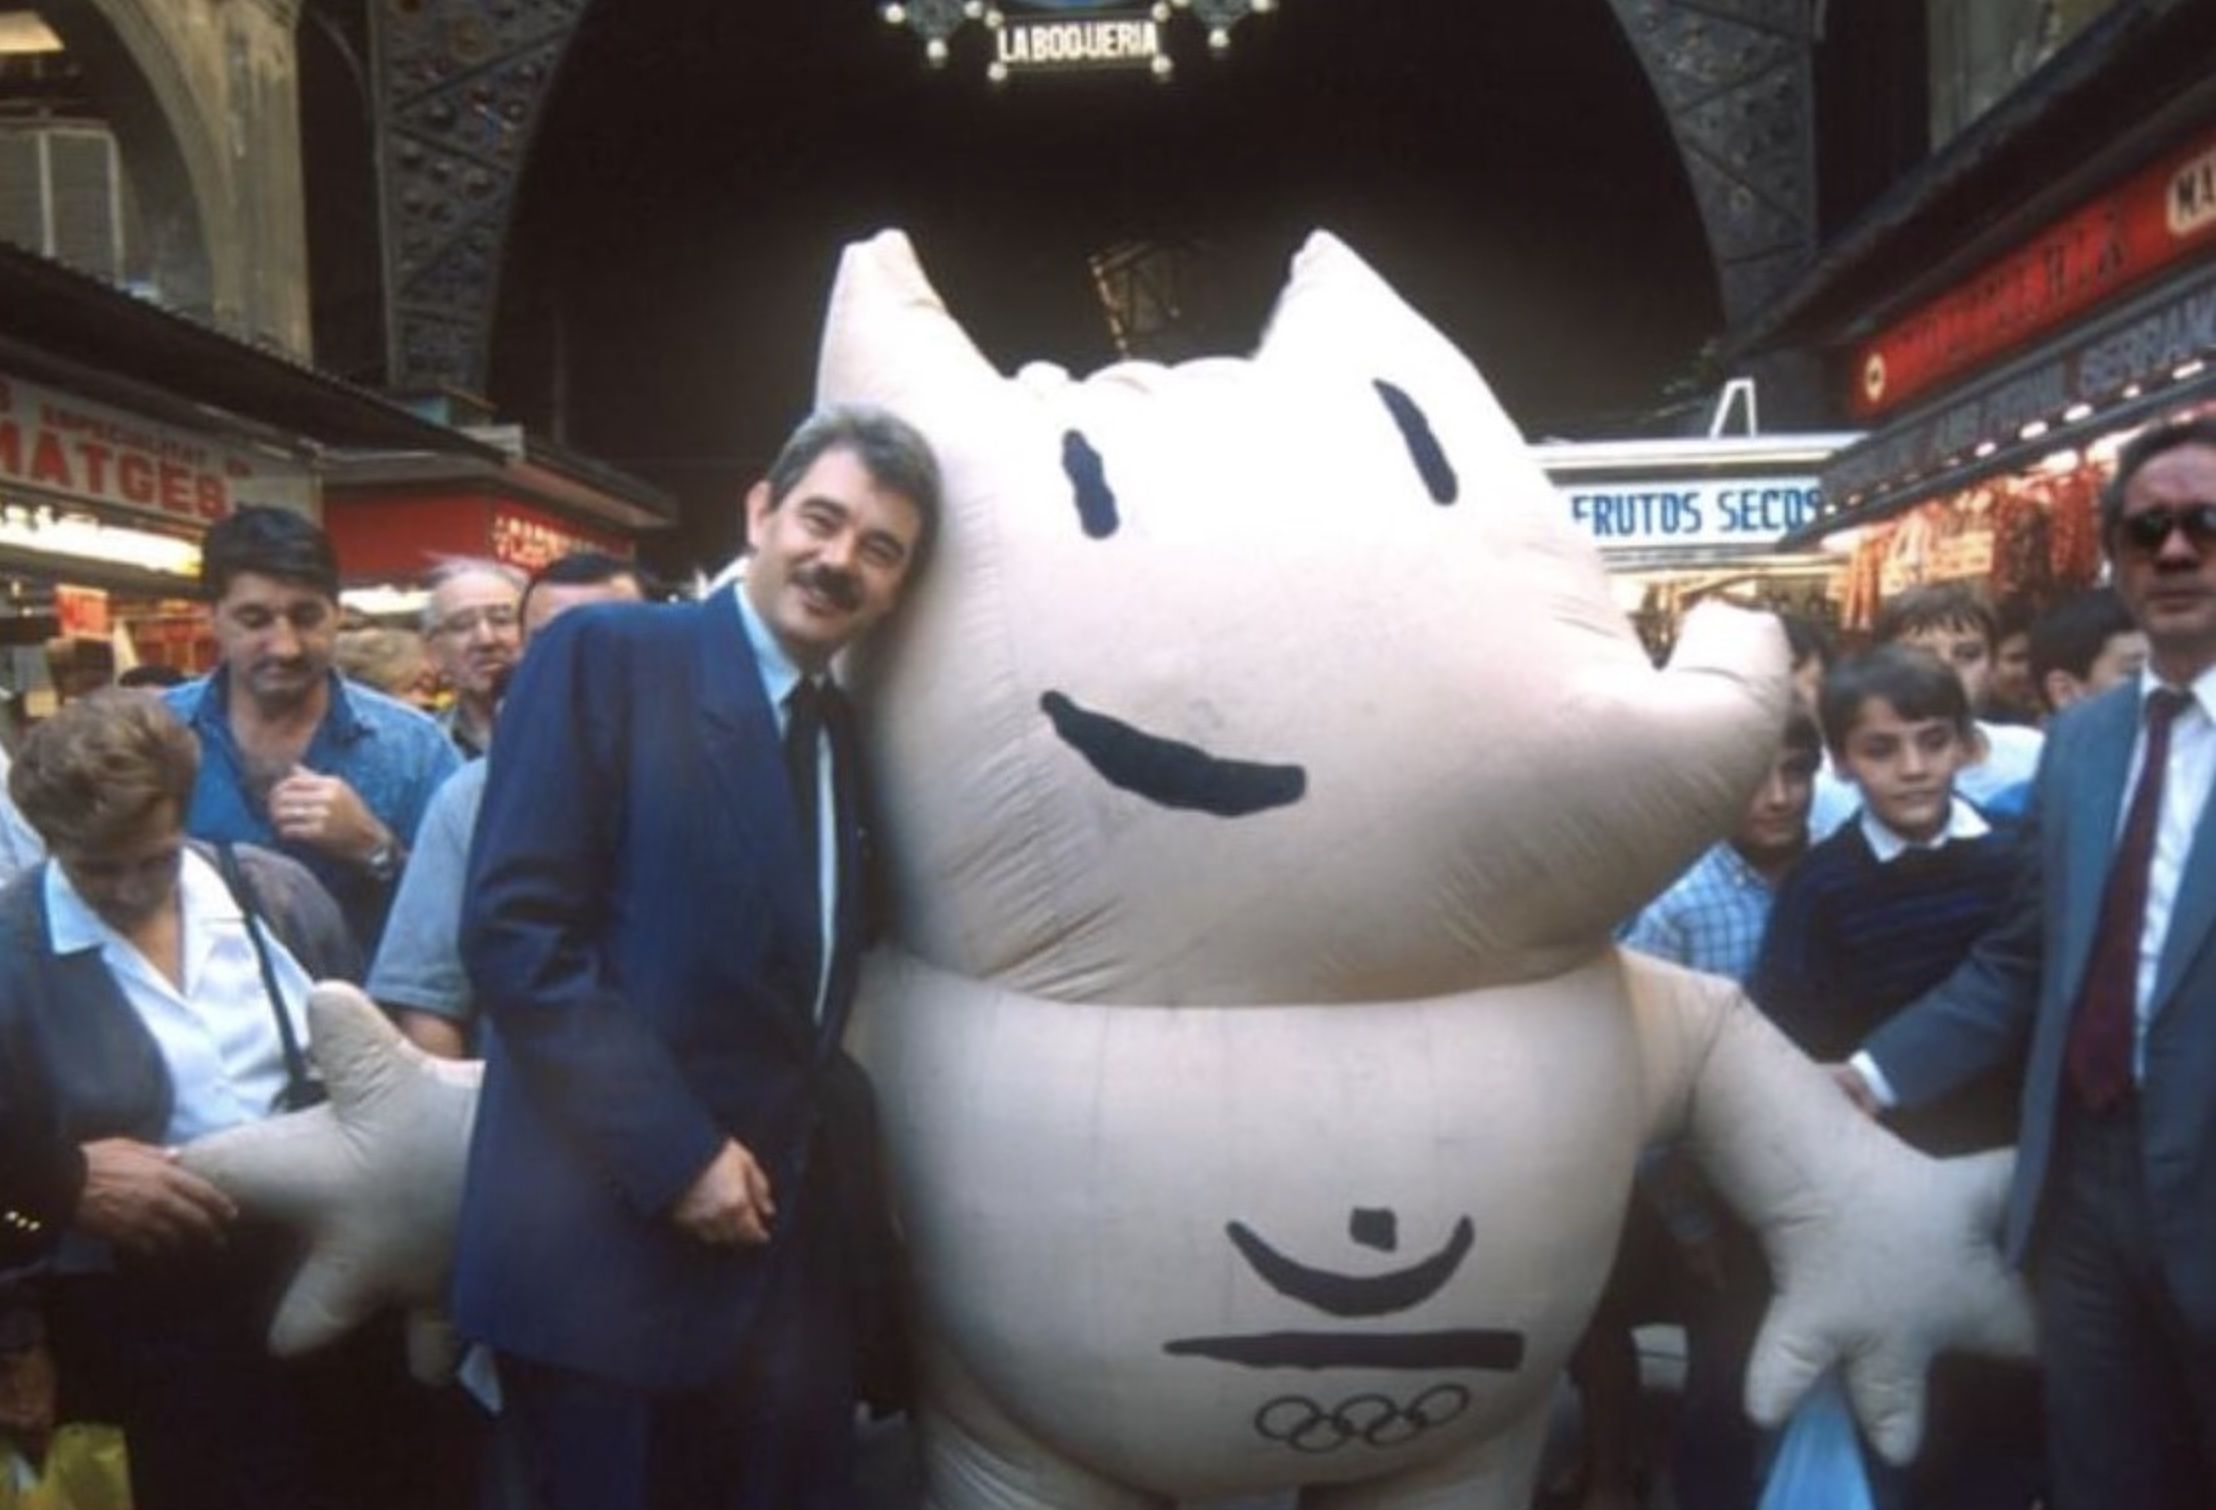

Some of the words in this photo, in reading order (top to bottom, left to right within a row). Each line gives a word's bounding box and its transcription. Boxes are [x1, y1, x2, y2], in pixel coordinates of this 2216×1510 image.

[999, 27, 1029, 62] LA
[1030, 21, 1158, 61] BOQUERIA
[1572, 493, 1701, 536] FRUTOS
